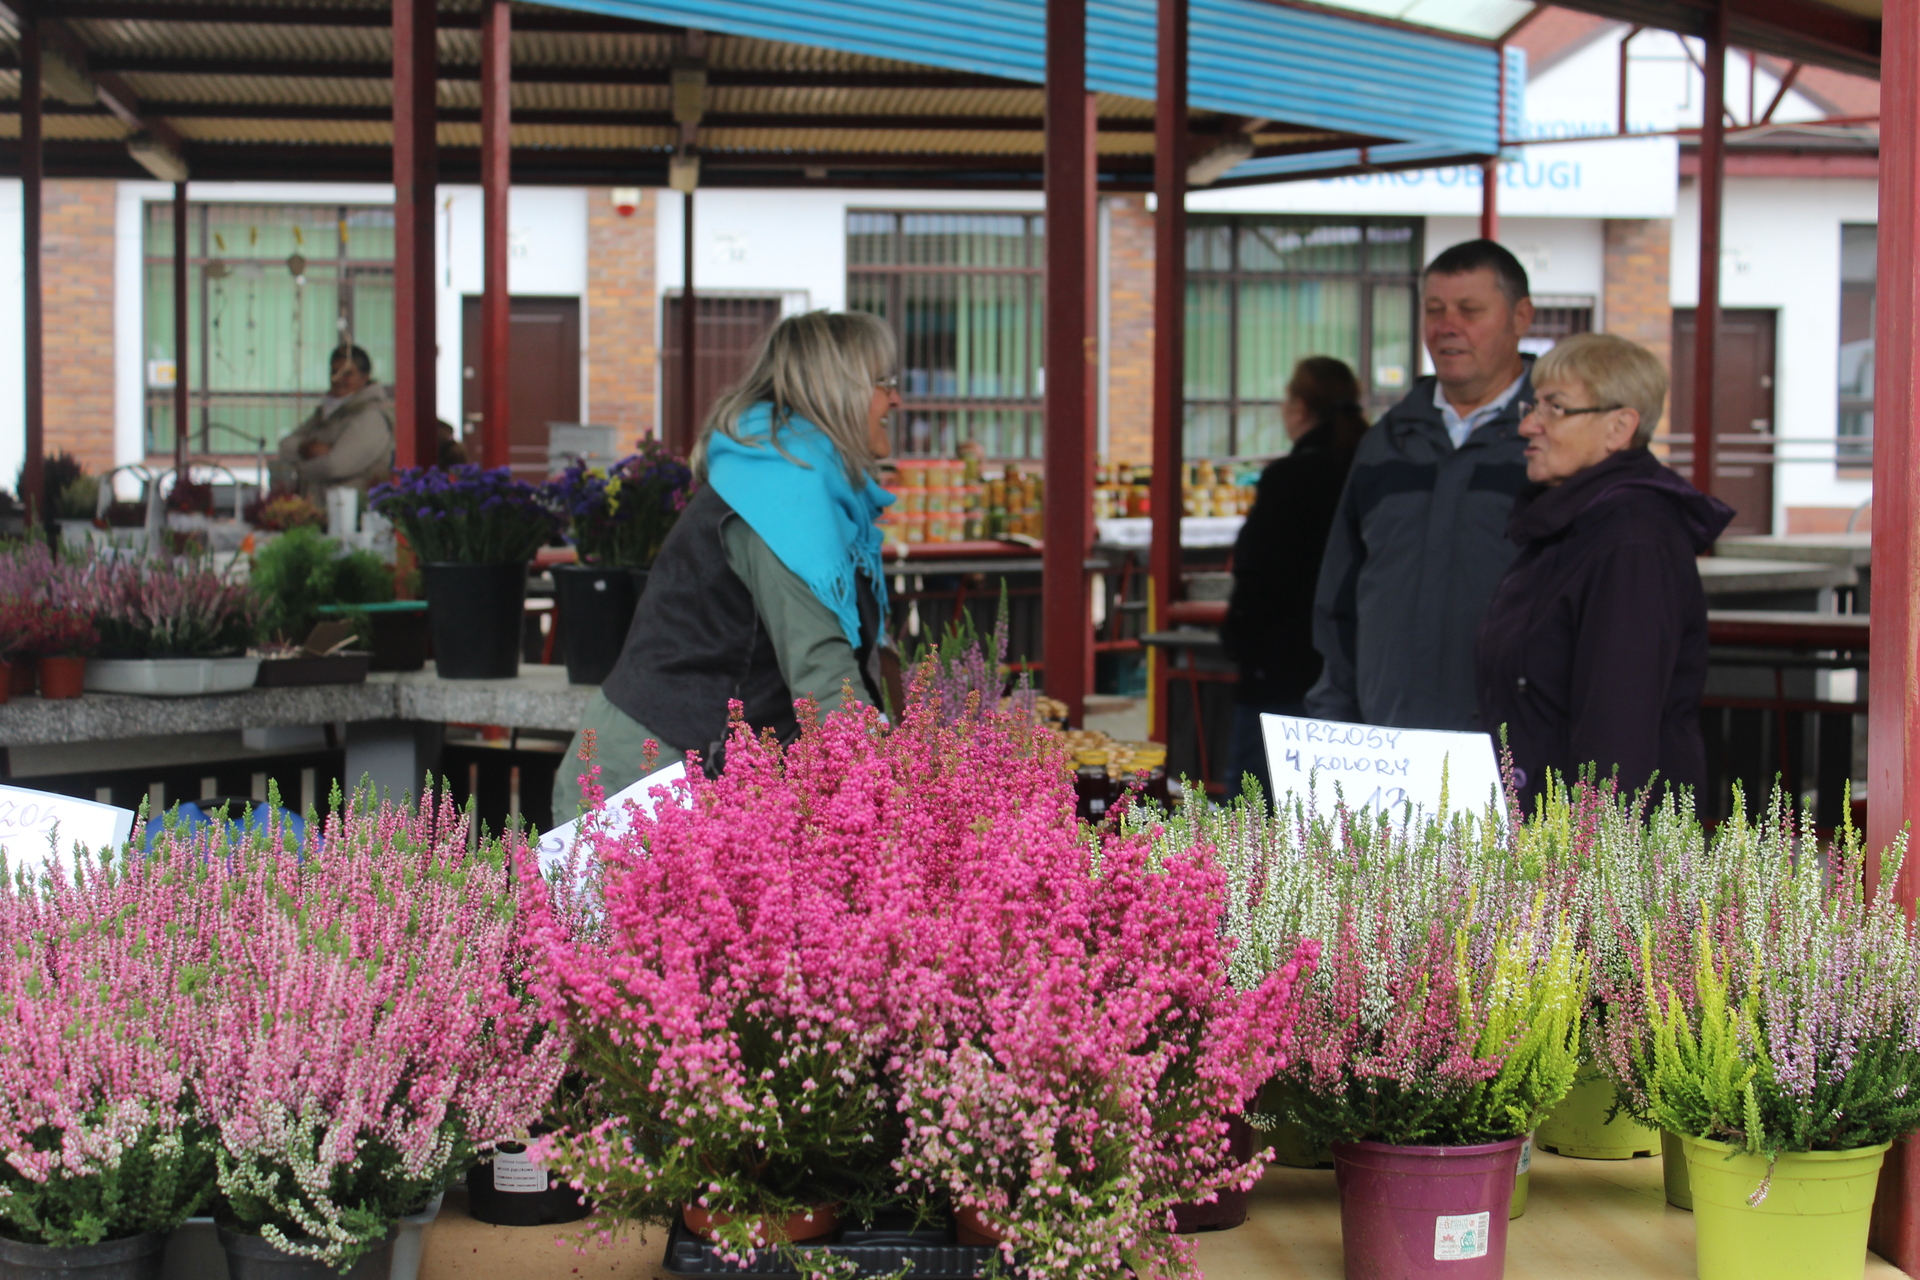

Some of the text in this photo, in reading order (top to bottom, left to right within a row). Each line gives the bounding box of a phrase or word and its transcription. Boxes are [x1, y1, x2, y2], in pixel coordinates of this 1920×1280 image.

[1436, 160, 1581, 189] OBŁUGI
[1281, 720, 1402, 749] WRZOSY
[1286, 748, 1410, 776] 4 KOLORY
[0, 800, 59, 833] ZOS
